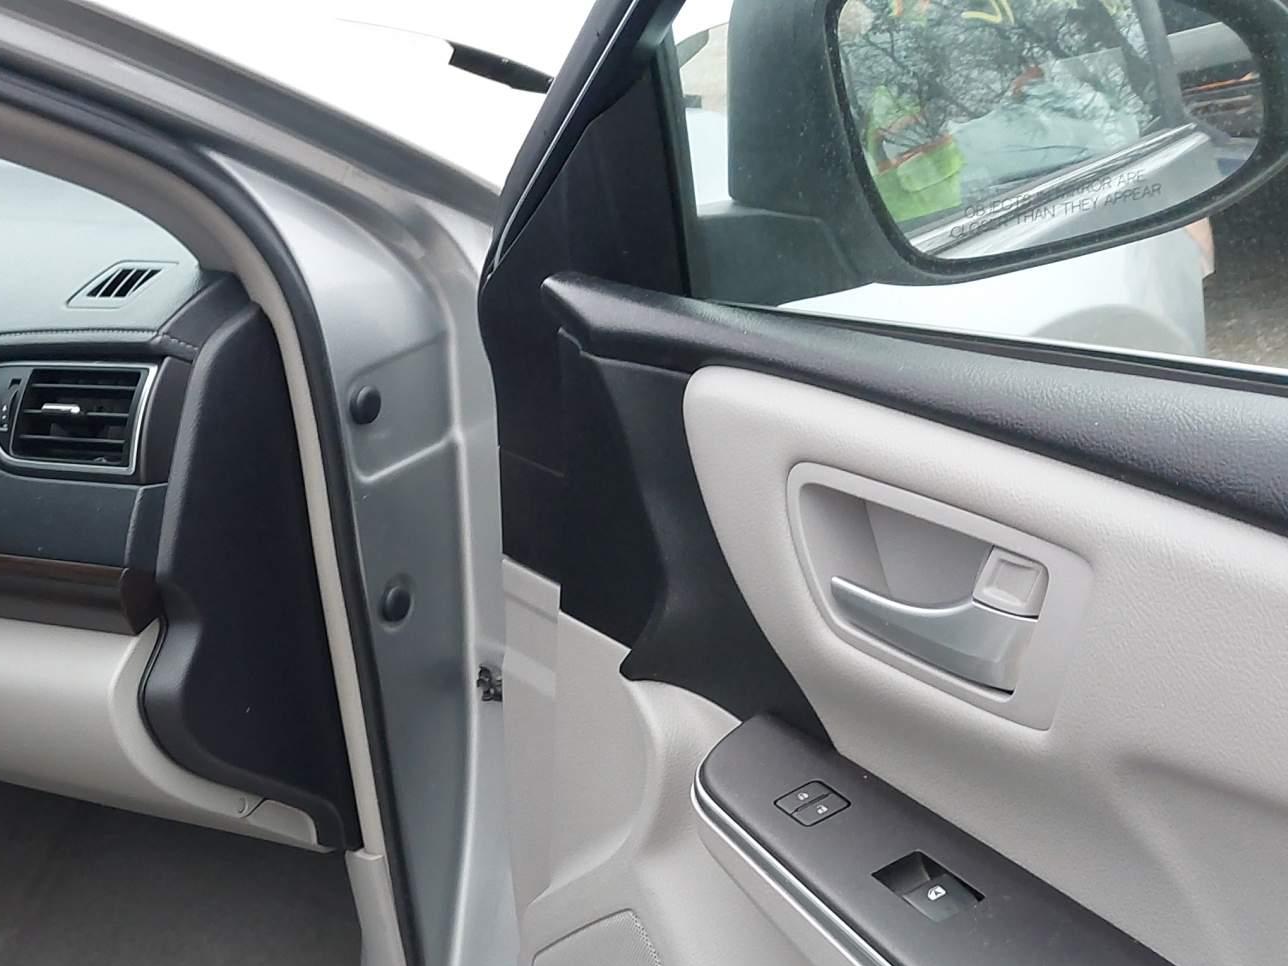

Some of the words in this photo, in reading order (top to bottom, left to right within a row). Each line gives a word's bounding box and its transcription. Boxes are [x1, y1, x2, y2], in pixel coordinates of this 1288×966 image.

[1116, 168, 1146, 189] ARE
[949, 217, 1009, 240] CLOS
[1015, 206, 1056, 225] THAN
[1062, 196, 1099, 216] THEY
[1104, 183, 1162, 207] APPEAR
